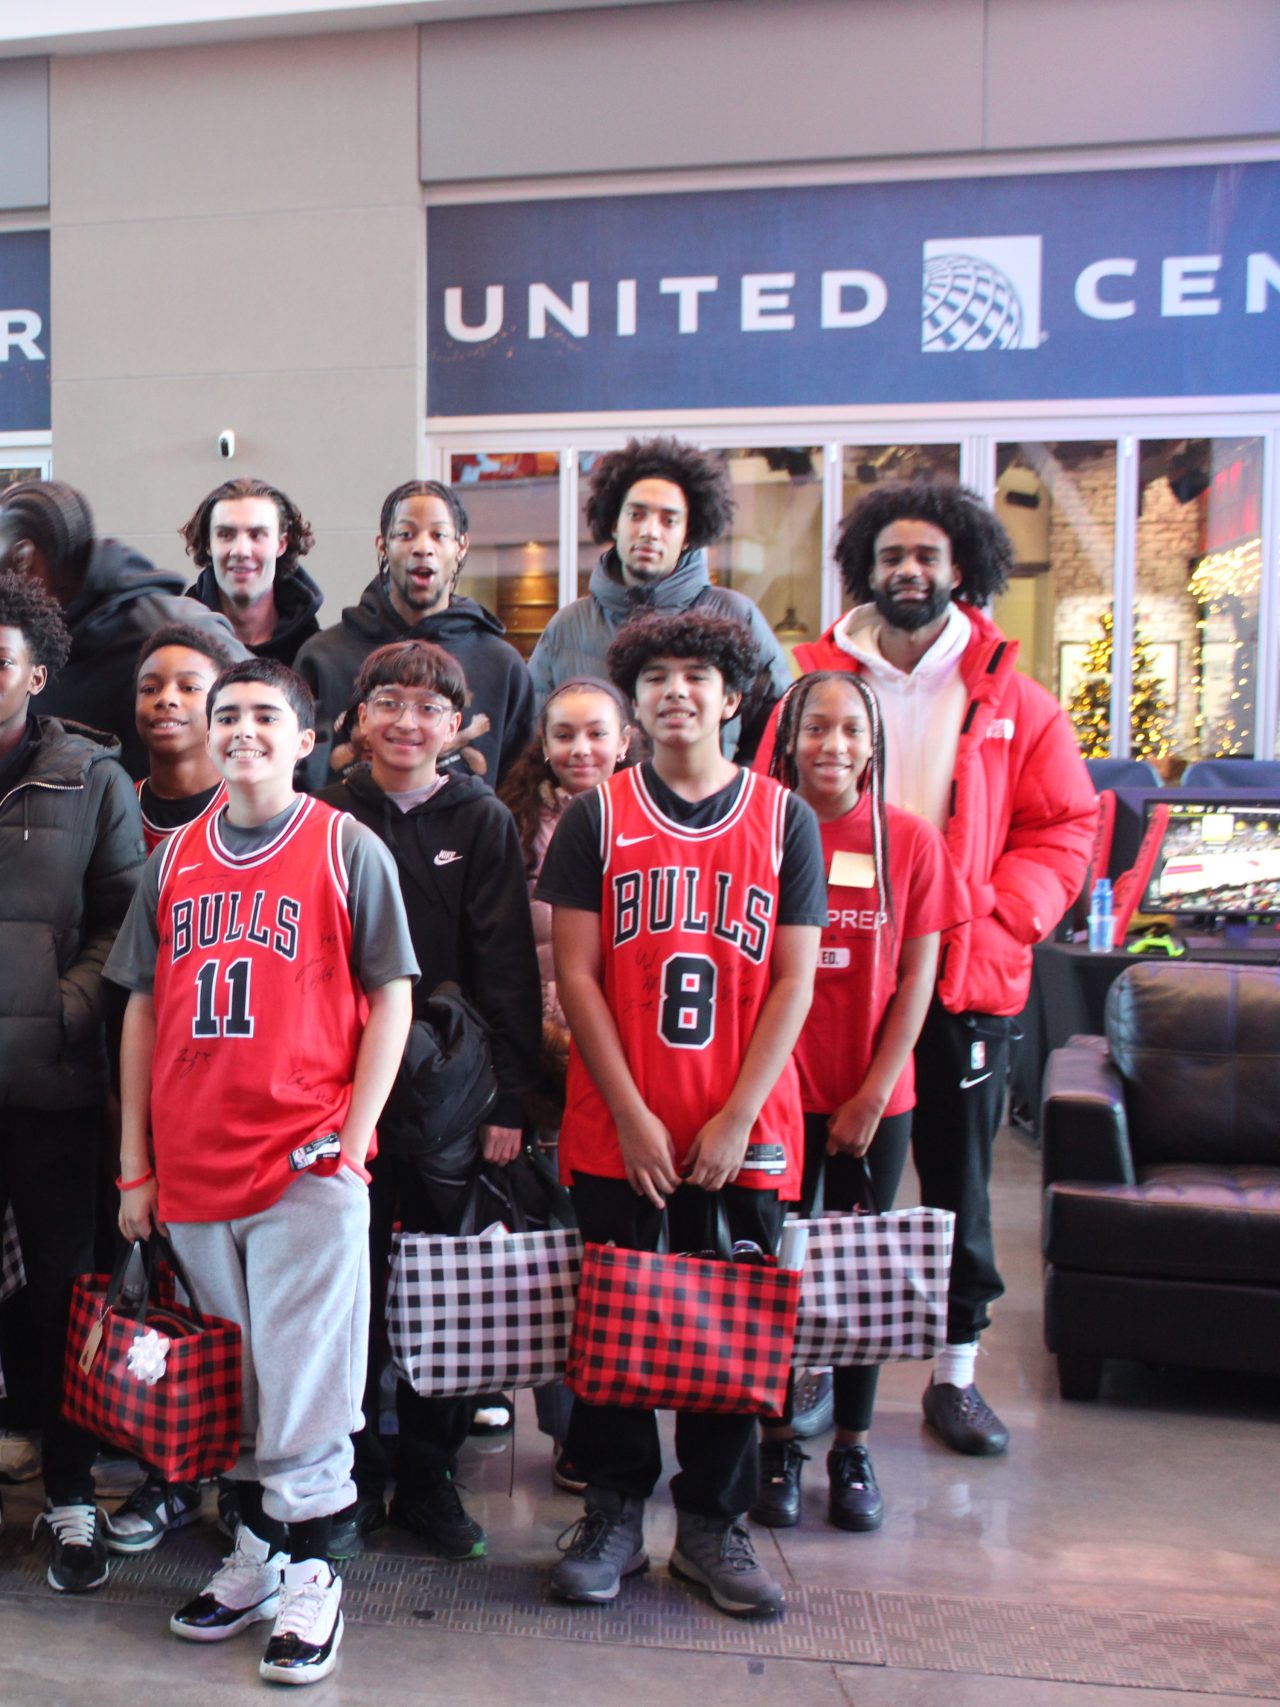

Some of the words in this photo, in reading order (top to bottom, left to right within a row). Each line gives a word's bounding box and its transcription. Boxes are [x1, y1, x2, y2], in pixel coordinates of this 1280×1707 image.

[444, 270, 888, 342] UNITED
[171, 890, 301, 965] BULLS
[613, 866, 774, 966] BULLS
[192, 957, 254, 1039] 11
[657, 951, 718, 1051] 8
